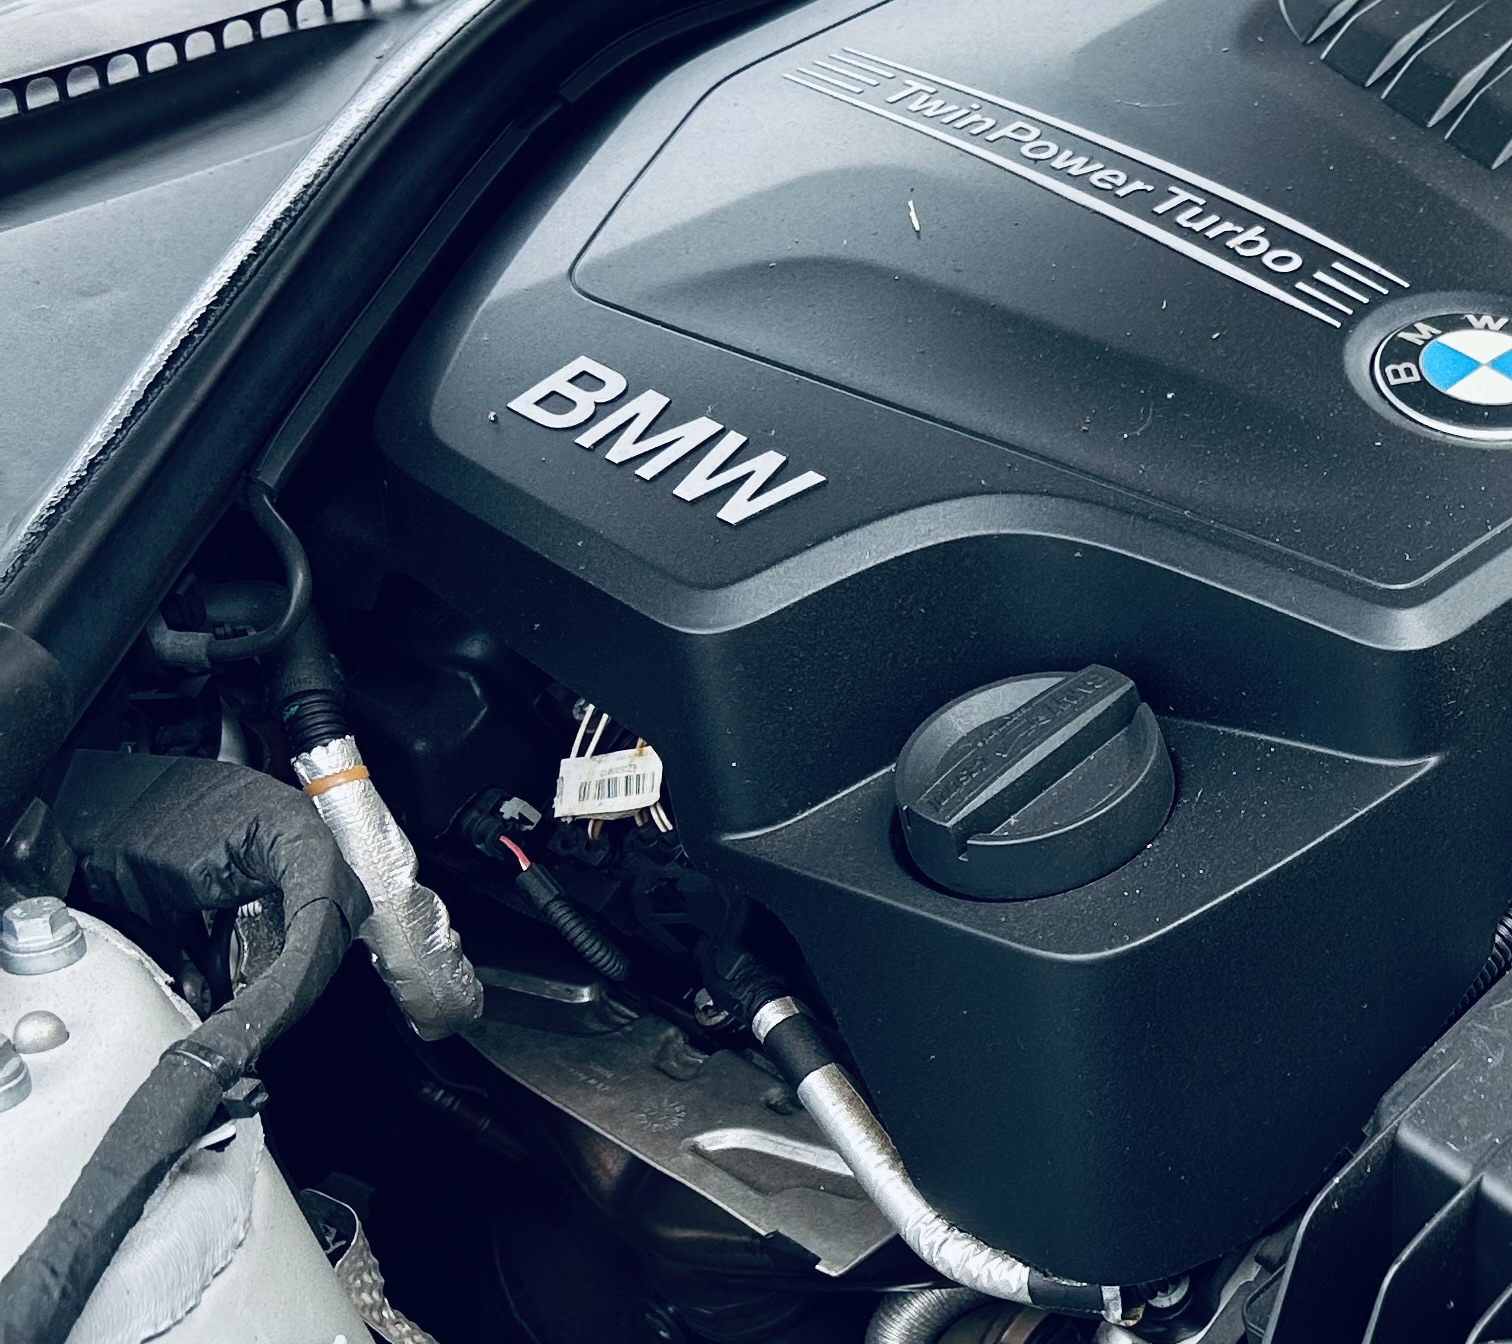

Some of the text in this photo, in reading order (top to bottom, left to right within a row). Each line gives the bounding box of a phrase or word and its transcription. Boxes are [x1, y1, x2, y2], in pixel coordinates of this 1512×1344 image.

[885, 78, 1303, 274] TwinPower Turbo
[1385, 313, 1509, 386] BMW
[506, 354, 828, 526] BMW
